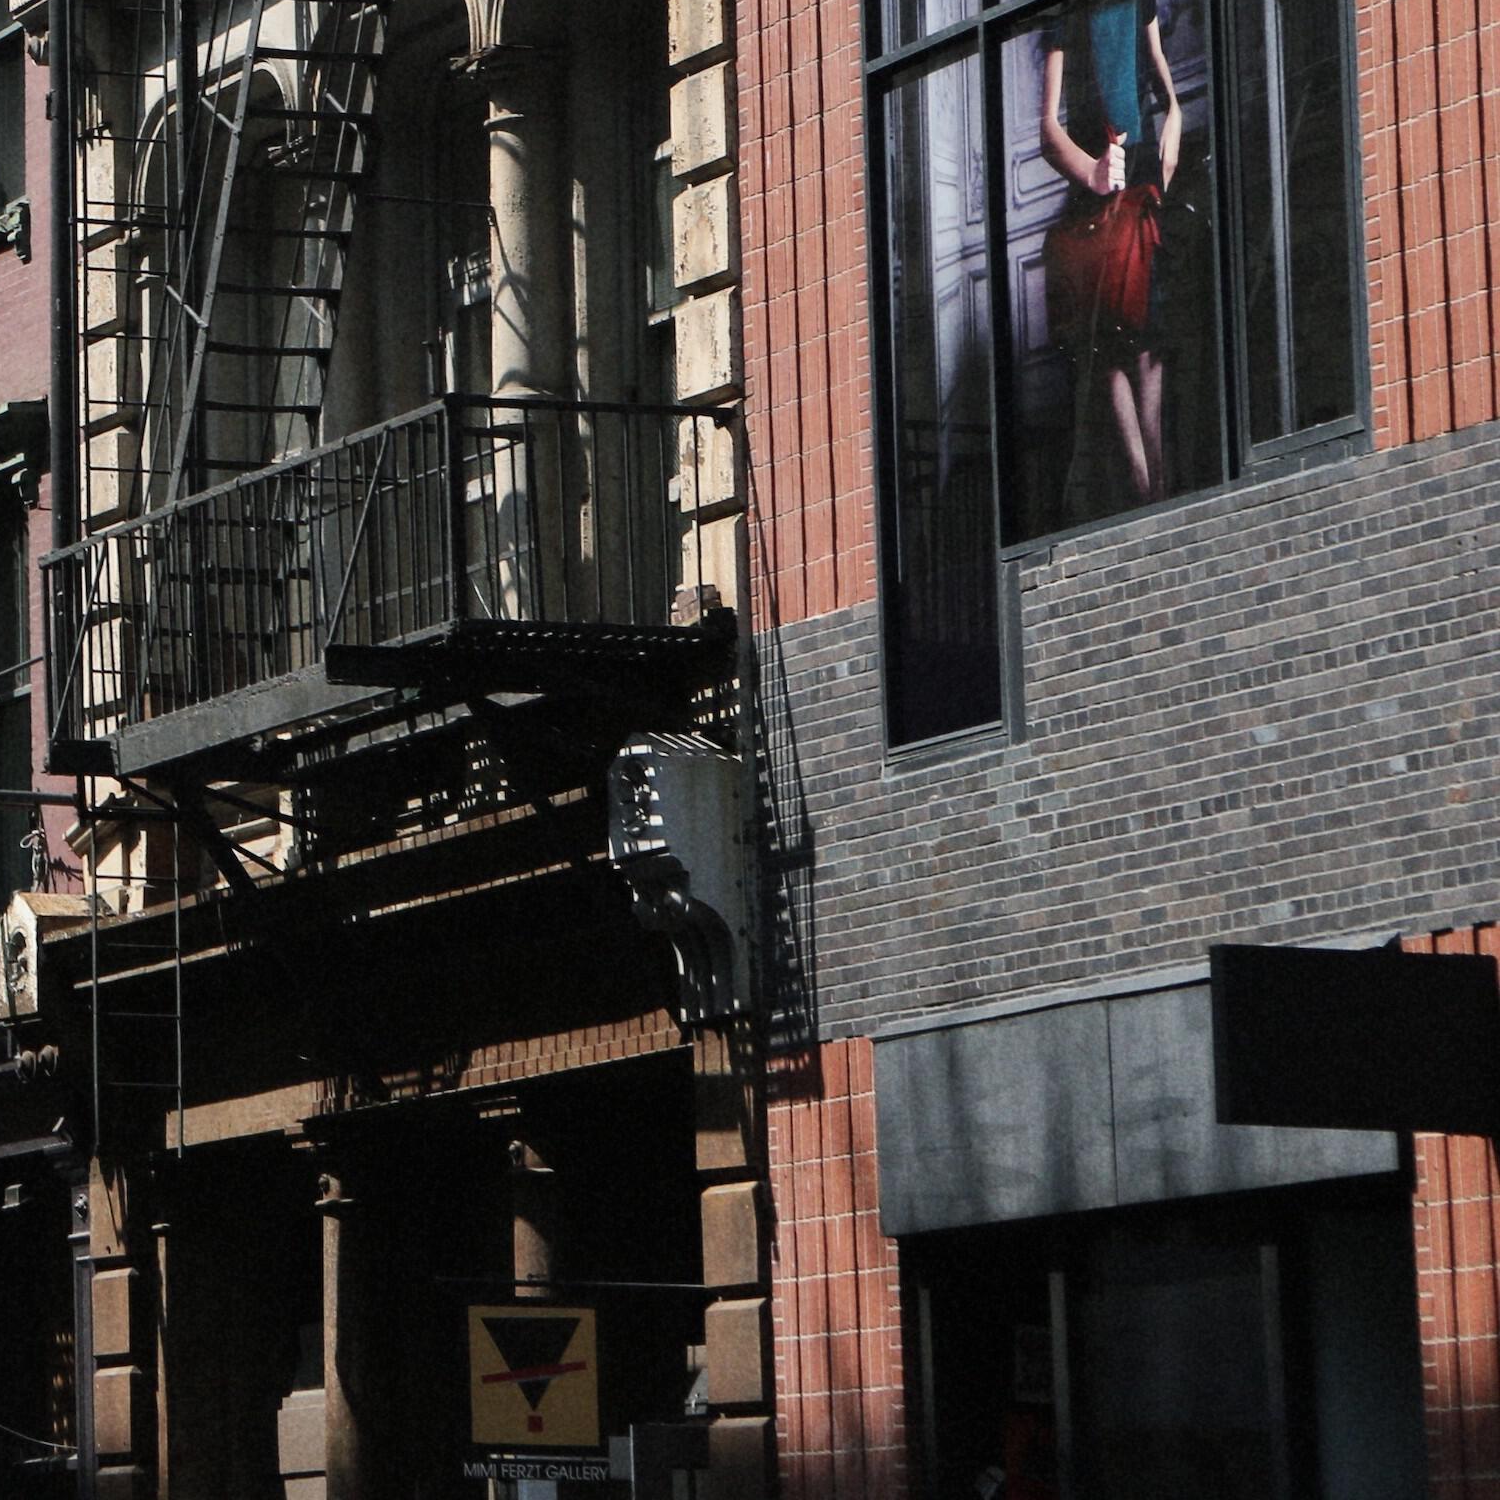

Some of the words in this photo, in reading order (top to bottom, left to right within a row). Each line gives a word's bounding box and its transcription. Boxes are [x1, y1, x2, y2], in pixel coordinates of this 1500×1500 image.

[463, 1462, 497, 1477] MIMI
[500, 1463, 543, 1479] FERZT
[545, 1464, 610, 1481] GALLERY
